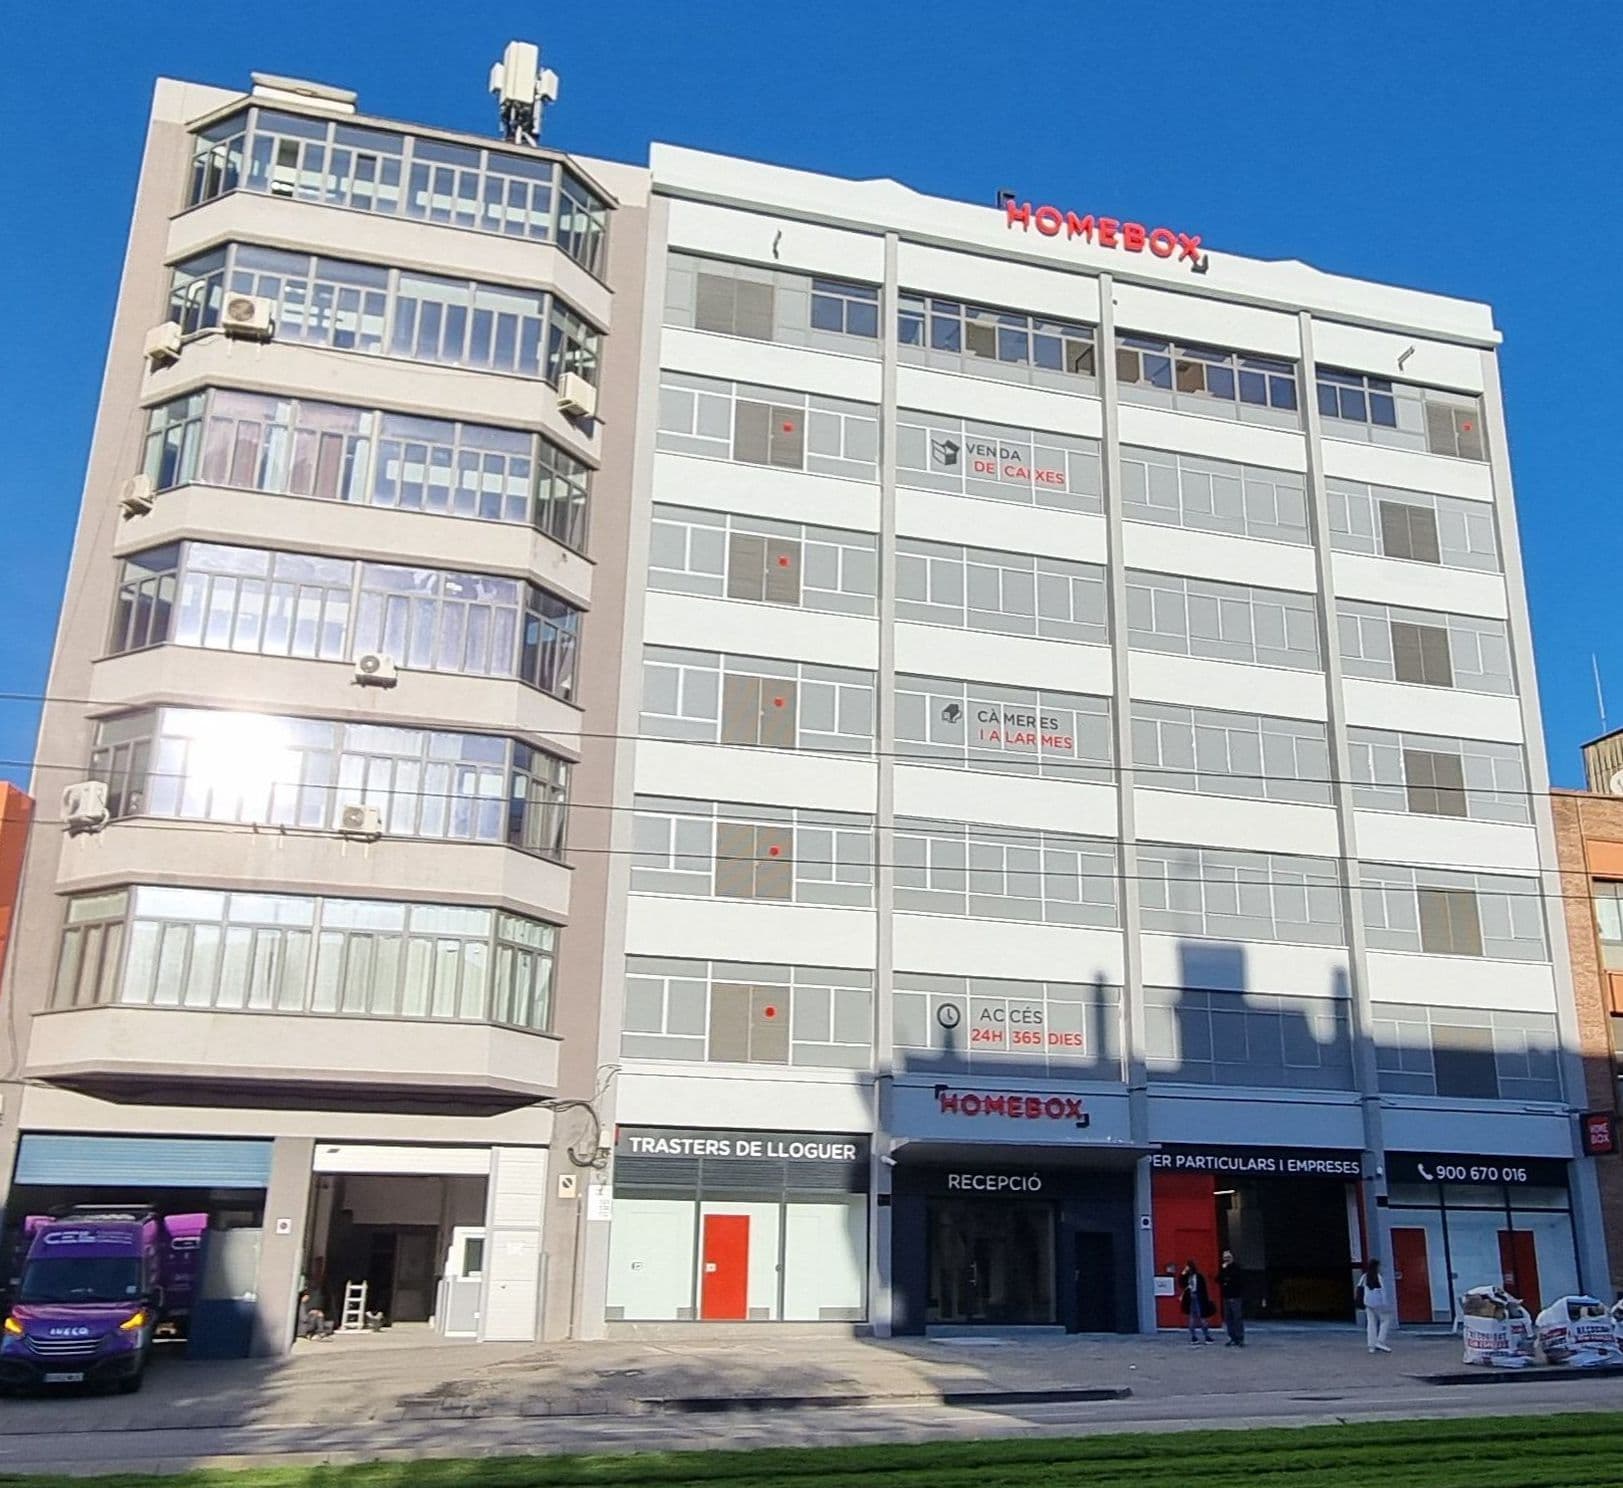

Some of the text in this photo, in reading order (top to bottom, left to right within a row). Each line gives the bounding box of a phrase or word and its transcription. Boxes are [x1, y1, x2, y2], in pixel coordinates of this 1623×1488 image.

[1006, 199, 1201, 263] HOMEBOX
[965, 442, 1022, 462] VENDA
[974, 461, 1065, 485] DE CAIXES
[977, 708, 1059, 730] CÀMERES
[980, 1006, 1043, 1024] ACCÉS
[970, 1028, 1082, 1046] 24H 365 DIES
[940, 1093, 1082, 1120] HOMEBOX
[629, 1137, 856, 1160] TRASTERS DE LLOGUER
[1176, 1155, 1276, 1171] PARTICULARS
[1279, 1159, 1284, 1171] I
[1287, 1159, 1360, 1174] EMPRESES
[1436, 1165, 1527, 1182] 900 670 016
[948, 1172, 1042, 1191] RECEPCIÓ
[50, 1327, 89, 1336] IVECO
